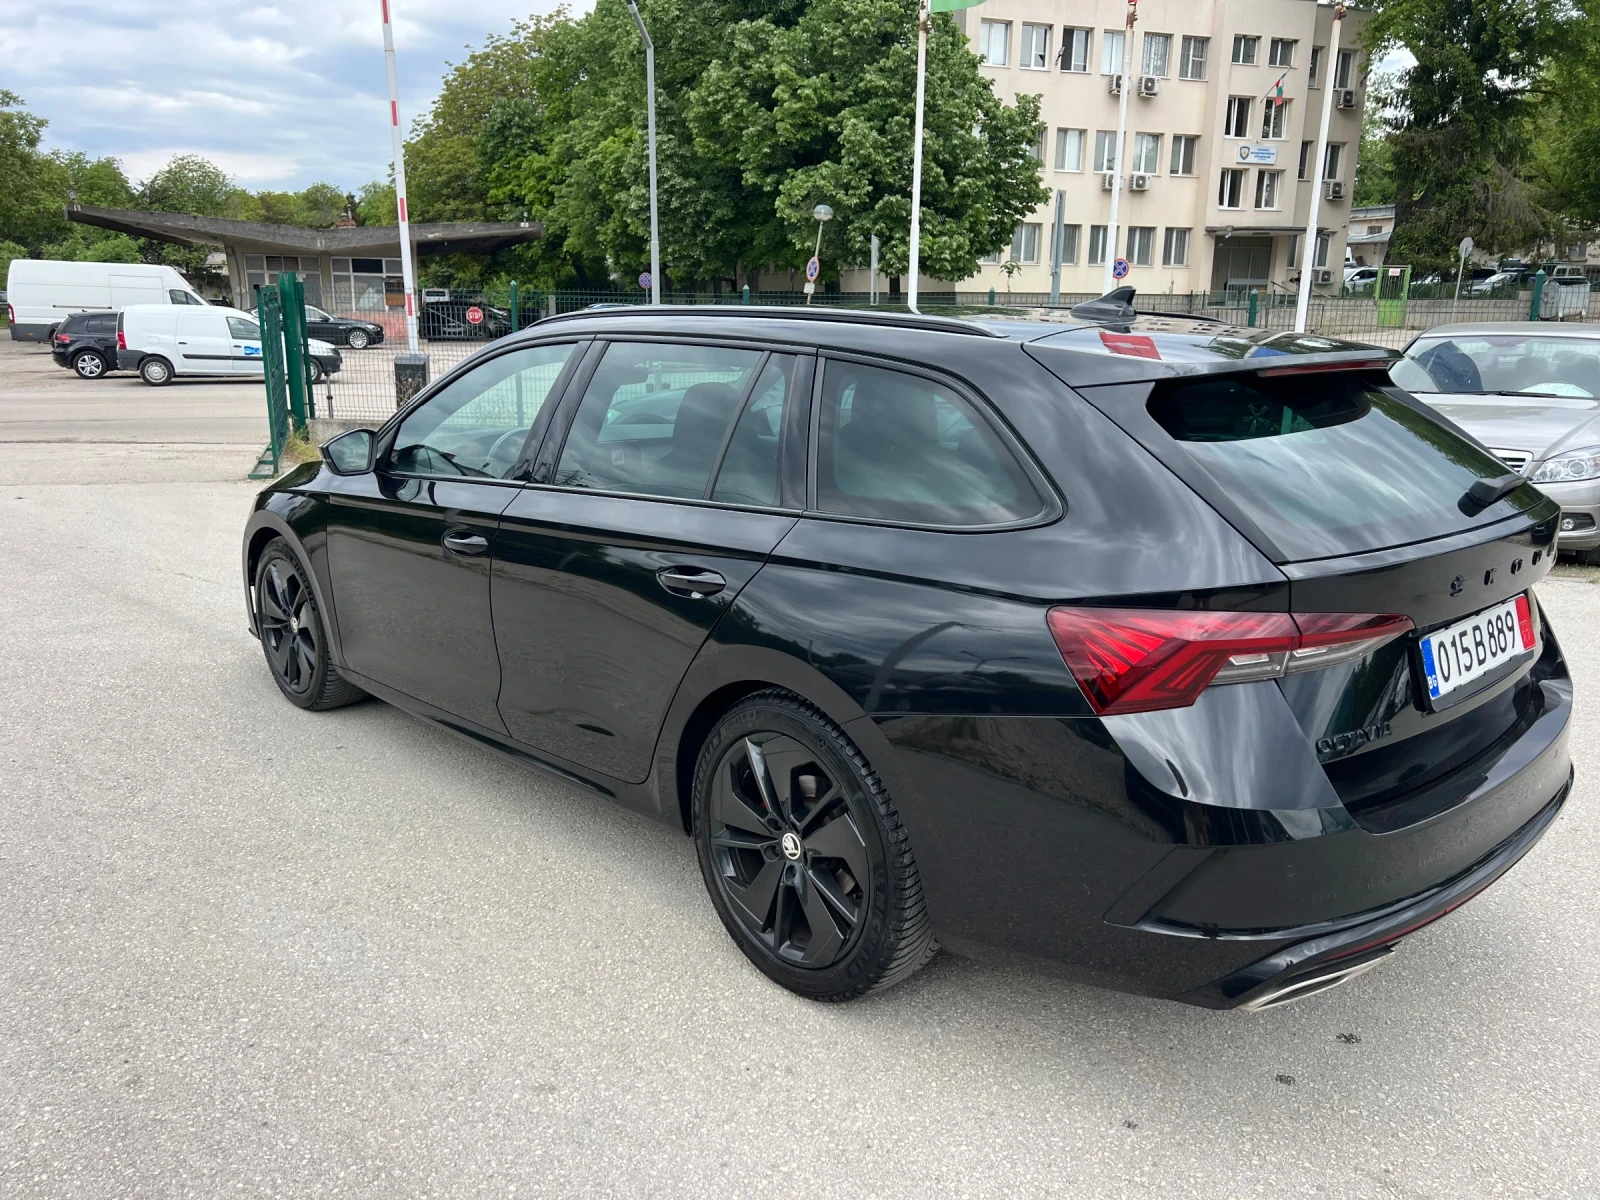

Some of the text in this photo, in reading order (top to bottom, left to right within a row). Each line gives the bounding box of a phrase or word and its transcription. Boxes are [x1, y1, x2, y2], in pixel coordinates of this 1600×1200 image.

[1427, 674, 1438, 690] BG
[1315, 721, 1392, 754] OCTAVIA
[694, 732, 720, 813] MICHELIN
